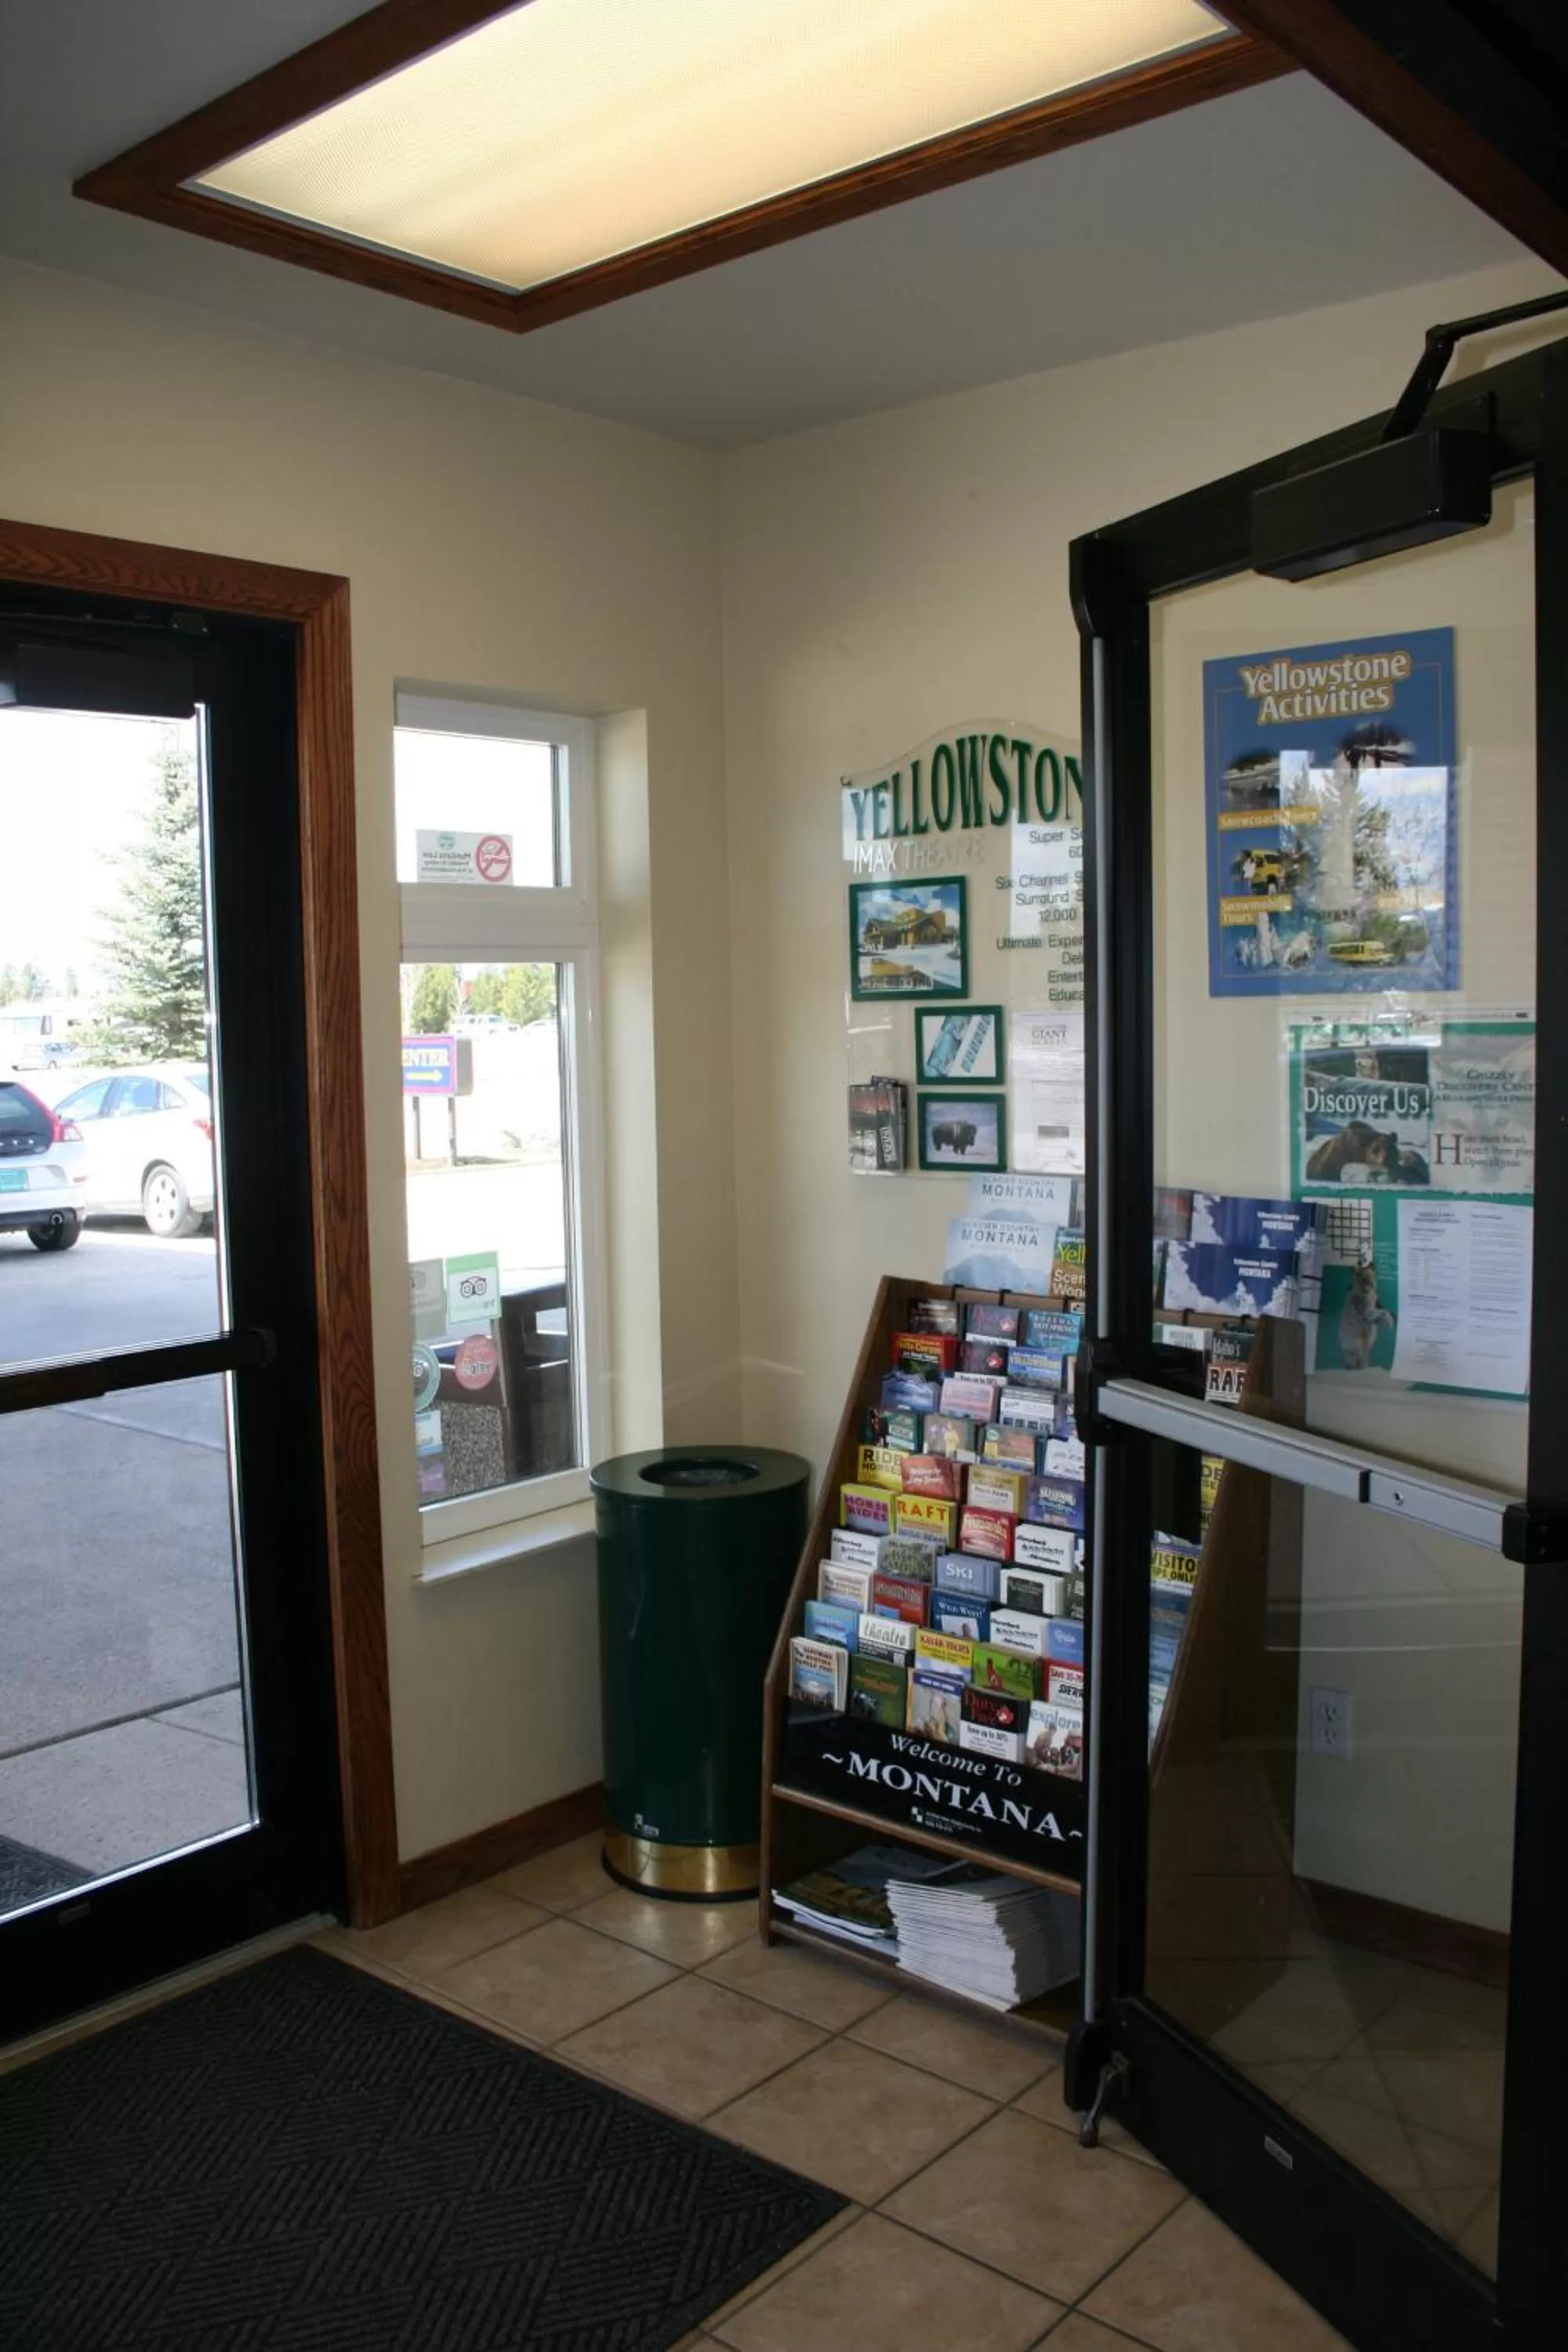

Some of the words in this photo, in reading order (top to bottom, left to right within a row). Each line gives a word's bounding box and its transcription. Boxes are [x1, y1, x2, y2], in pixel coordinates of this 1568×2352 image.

[1242, 652, 1409, 695] Yellowstone
[1260, 683, 1391, 722] Activities
[1029, 829, 1064, 844] Super
[853, 841, 898, 874] IMAX
[995, 875, 1014, 890] Six
[1019, 873, 1069, 888] Channel
[1015, 890, 1069, 906] Surround
[996, 935, 1043, 951] Ultimate
[1304, 1087, 1388, 1114] Discover
[1392, 1087, 1419, 1114] Us
[982, 1183, 1054, 1200] MONTANA
[961, 1229, 1038, 1247] MONTANA
[1212, 1335, 1240, 1358] Idaho's
[896, 1500, 947, 1522] RAFT
[946, 1563, 973, 1580] SKI
[864, 1619, 907, 1647] theatre
[1031, 1708, 1082, 1730] explore
[891, 1733, 987, 1777] Welcome
[993, 1766, 1022, 1788] To
